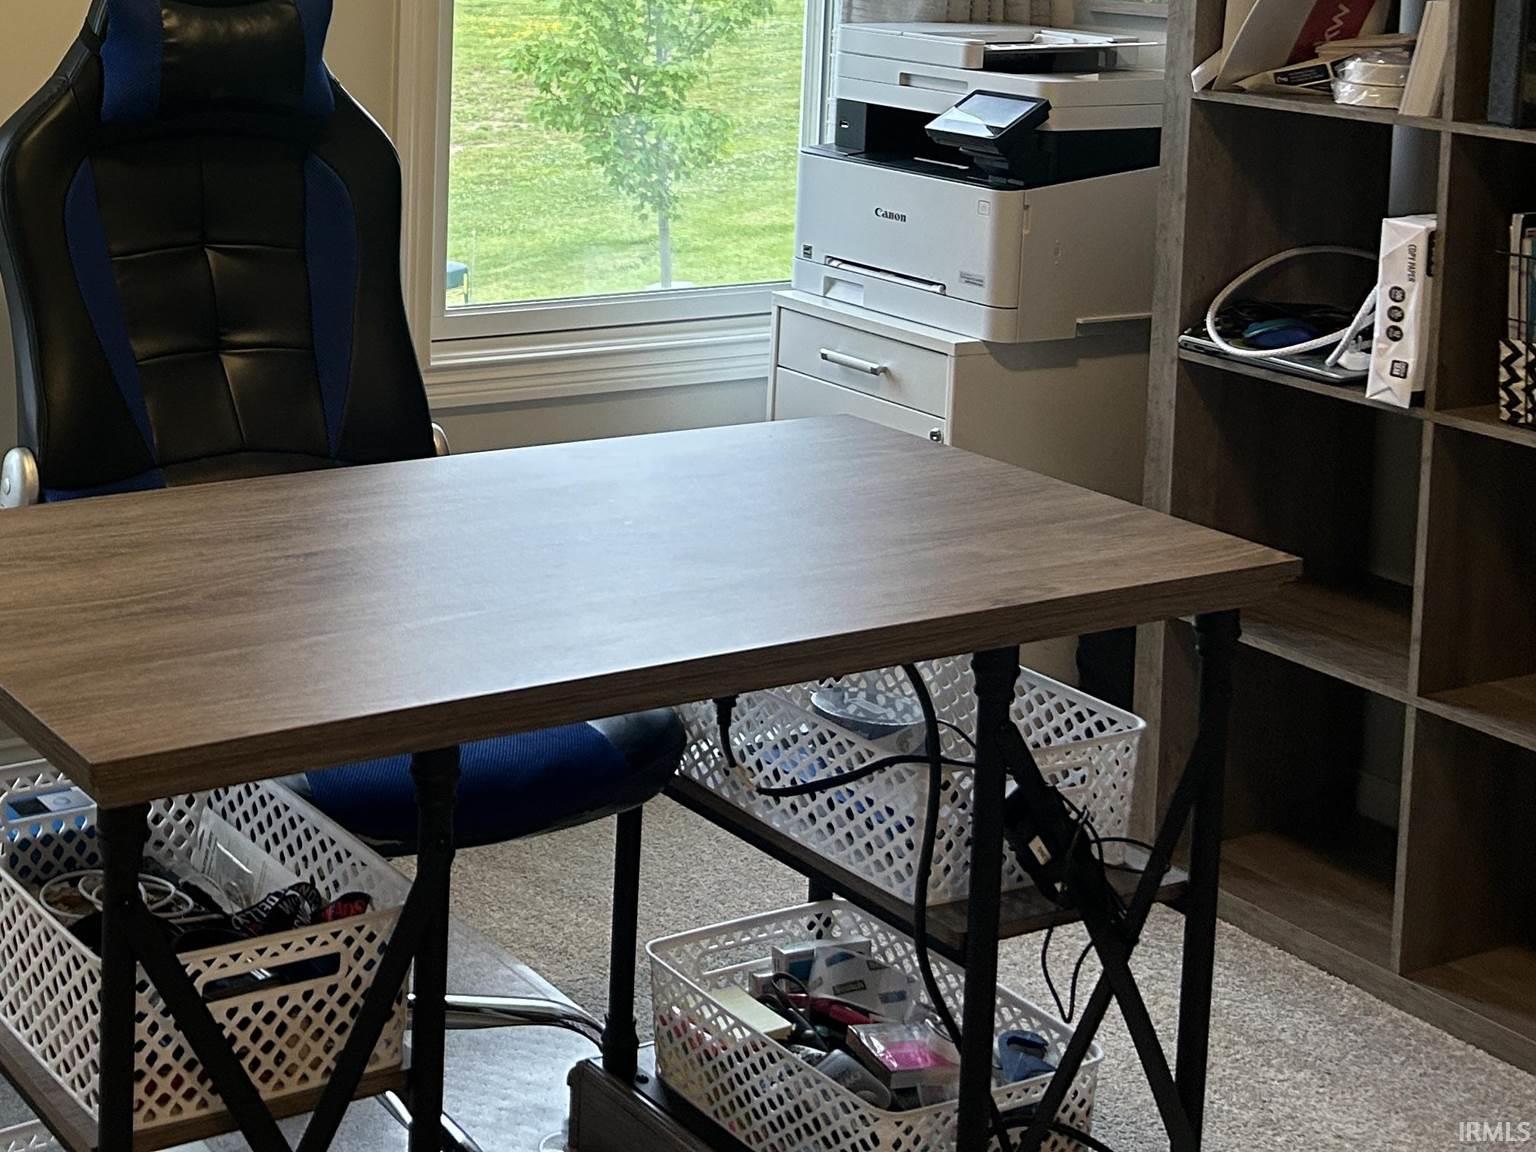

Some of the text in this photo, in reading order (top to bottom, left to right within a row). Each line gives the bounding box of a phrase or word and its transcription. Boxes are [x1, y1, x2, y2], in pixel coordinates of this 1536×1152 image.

[874, 207, 907, 223] Canon
[1407, 244, 1417, 282] COPY PAPER
